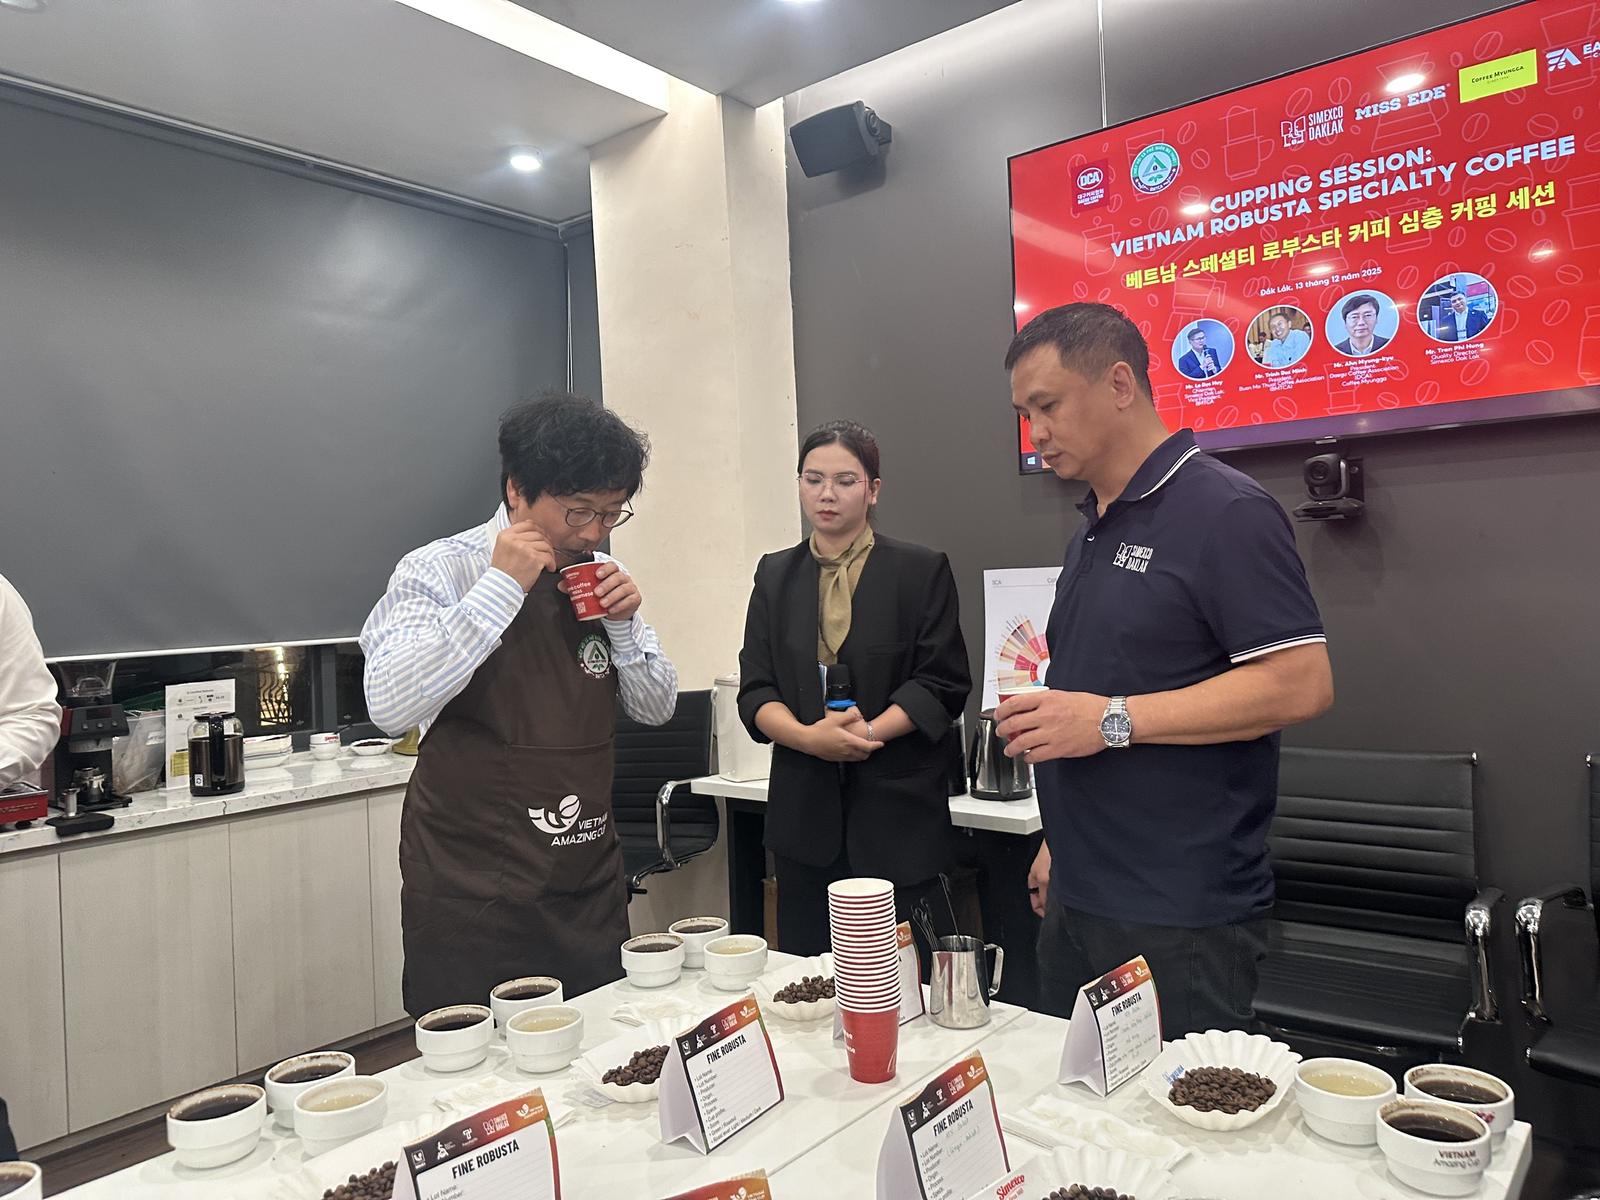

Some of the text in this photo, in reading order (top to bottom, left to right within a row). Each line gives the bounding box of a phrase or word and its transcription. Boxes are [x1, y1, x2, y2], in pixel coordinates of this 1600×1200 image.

[1471, 74, 1493, 83] COFFEE
[1494, 66, 1524, 77] MYUNGGA
[1354, 85, 1446, 120] MISS EDE
[1308, 105, 1344, 126] SIMEXCO
[1308, 119, 1344, 141] DAKLAK
[1080, 171, 1100, 187] DCA
[1209, 146, 1432, 214] CUPPING SESSION:
[1110, 134, 1576, 257] VIETNAM ROBUSTA SPECIALTY COFFEE
[1125, 181, 1556, 289] 베트남 스페셜티 로부스타 커피 심층 커핑 세션
[1295, 282, 1304, 290] 13
[1305, 278, 1330, 289] tháng
[1331, 275, 1340, 283] 12
[1361, 266, 1383, 278] 2025
[551, 830, 597, 846] AMAZING
[1111, 992, 1142, 1016] FINE ROBUSTA
[706, 1034, 746, 1064] FINE ROBUSTA
[933, 1118, 948, 1136] FINE
[947, 1098, 974, 1126] ROBUSTA
[452, 1139, 520, 1179] FINE ROBUSTA
[1438, 1150, 1476, 1158] VIETNAM
[996, 1174, 1024, 1200] Simexco
